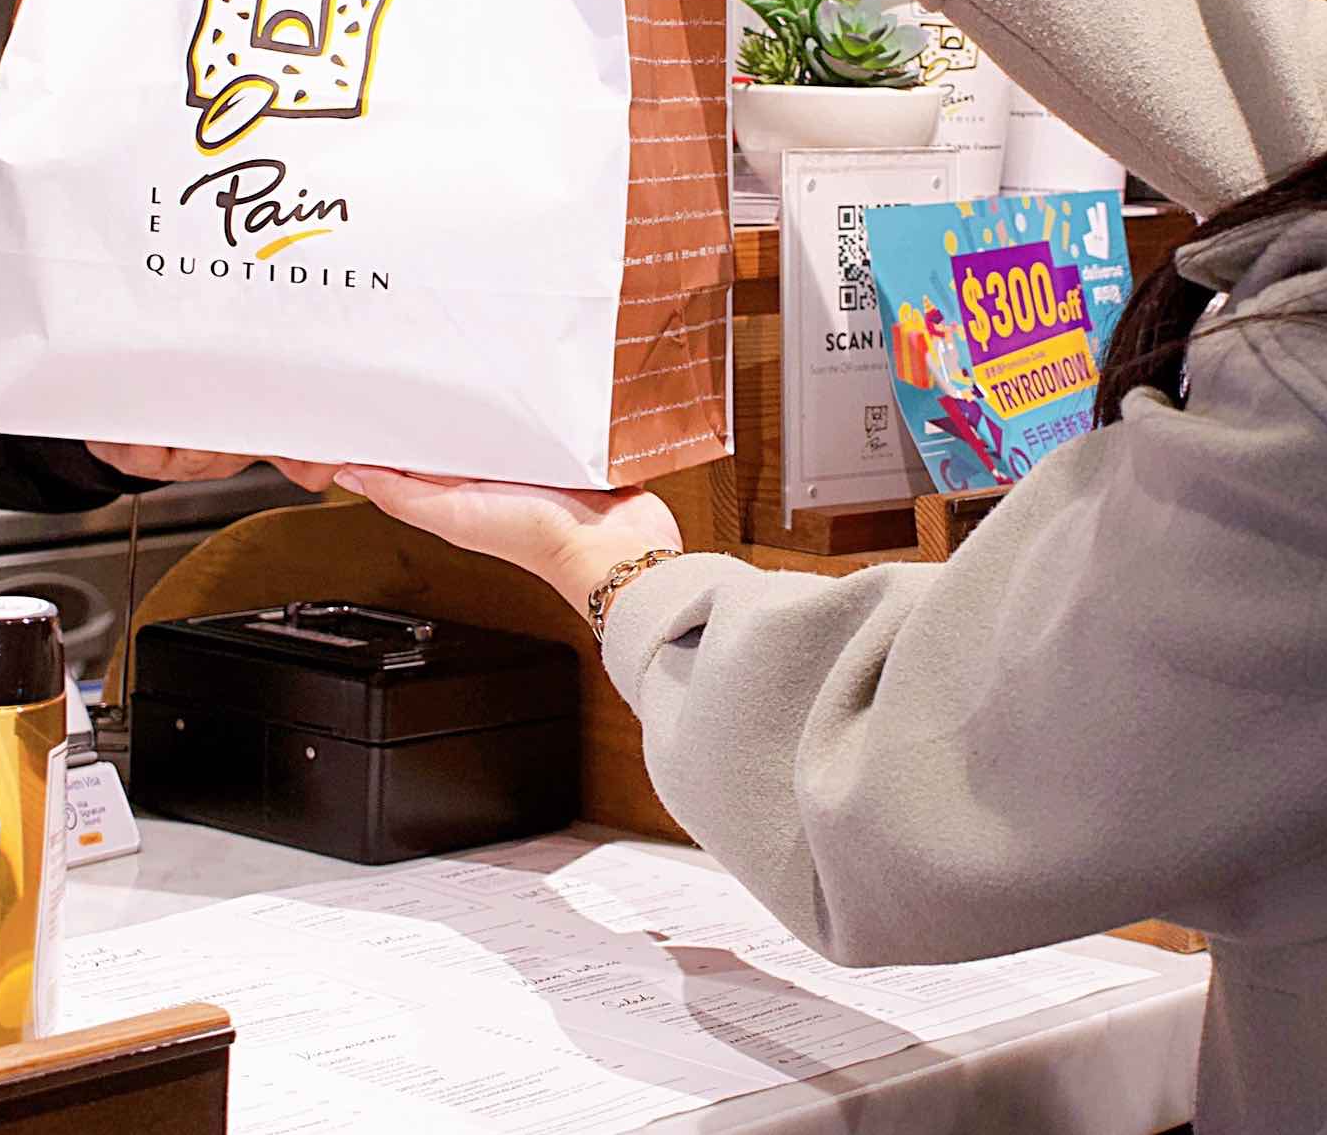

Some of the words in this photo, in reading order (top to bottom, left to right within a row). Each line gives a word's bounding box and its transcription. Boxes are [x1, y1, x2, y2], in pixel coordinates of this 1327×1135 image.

[179, 158, 349, 247] Pain
[145, 252, 391, 290] QUOTIDIEN
[826, 331, 873, 352] SCAN
[990, 351, 1094, 413] TRYROONOW
